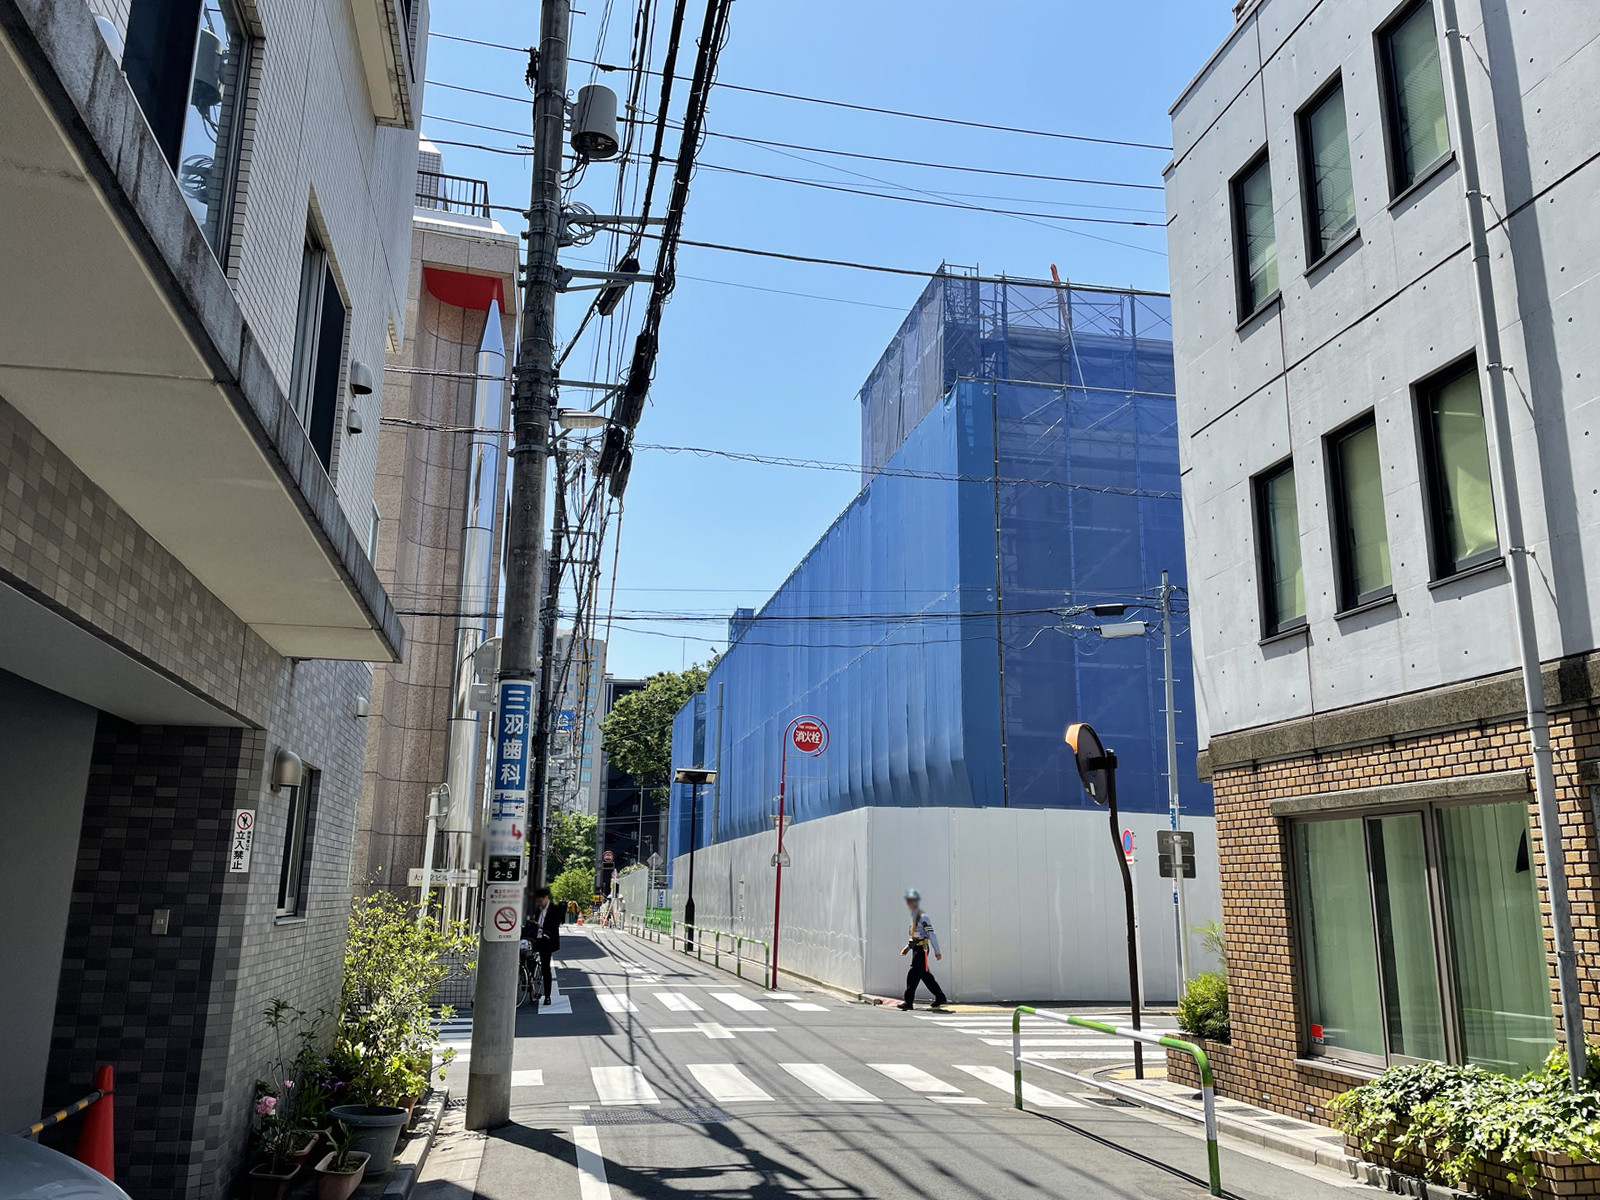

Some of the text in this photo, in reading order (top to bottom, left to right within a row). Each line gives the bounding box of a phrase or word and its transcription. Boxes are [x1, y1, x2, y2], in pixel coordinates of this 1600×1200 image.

[501, 690, 526, 785] 三羽歯科
[795, 730, 821, 744] 消火栓
[231, 830, 246, 870] 立入禁止
[494, 870, 513, 879] 2-5
